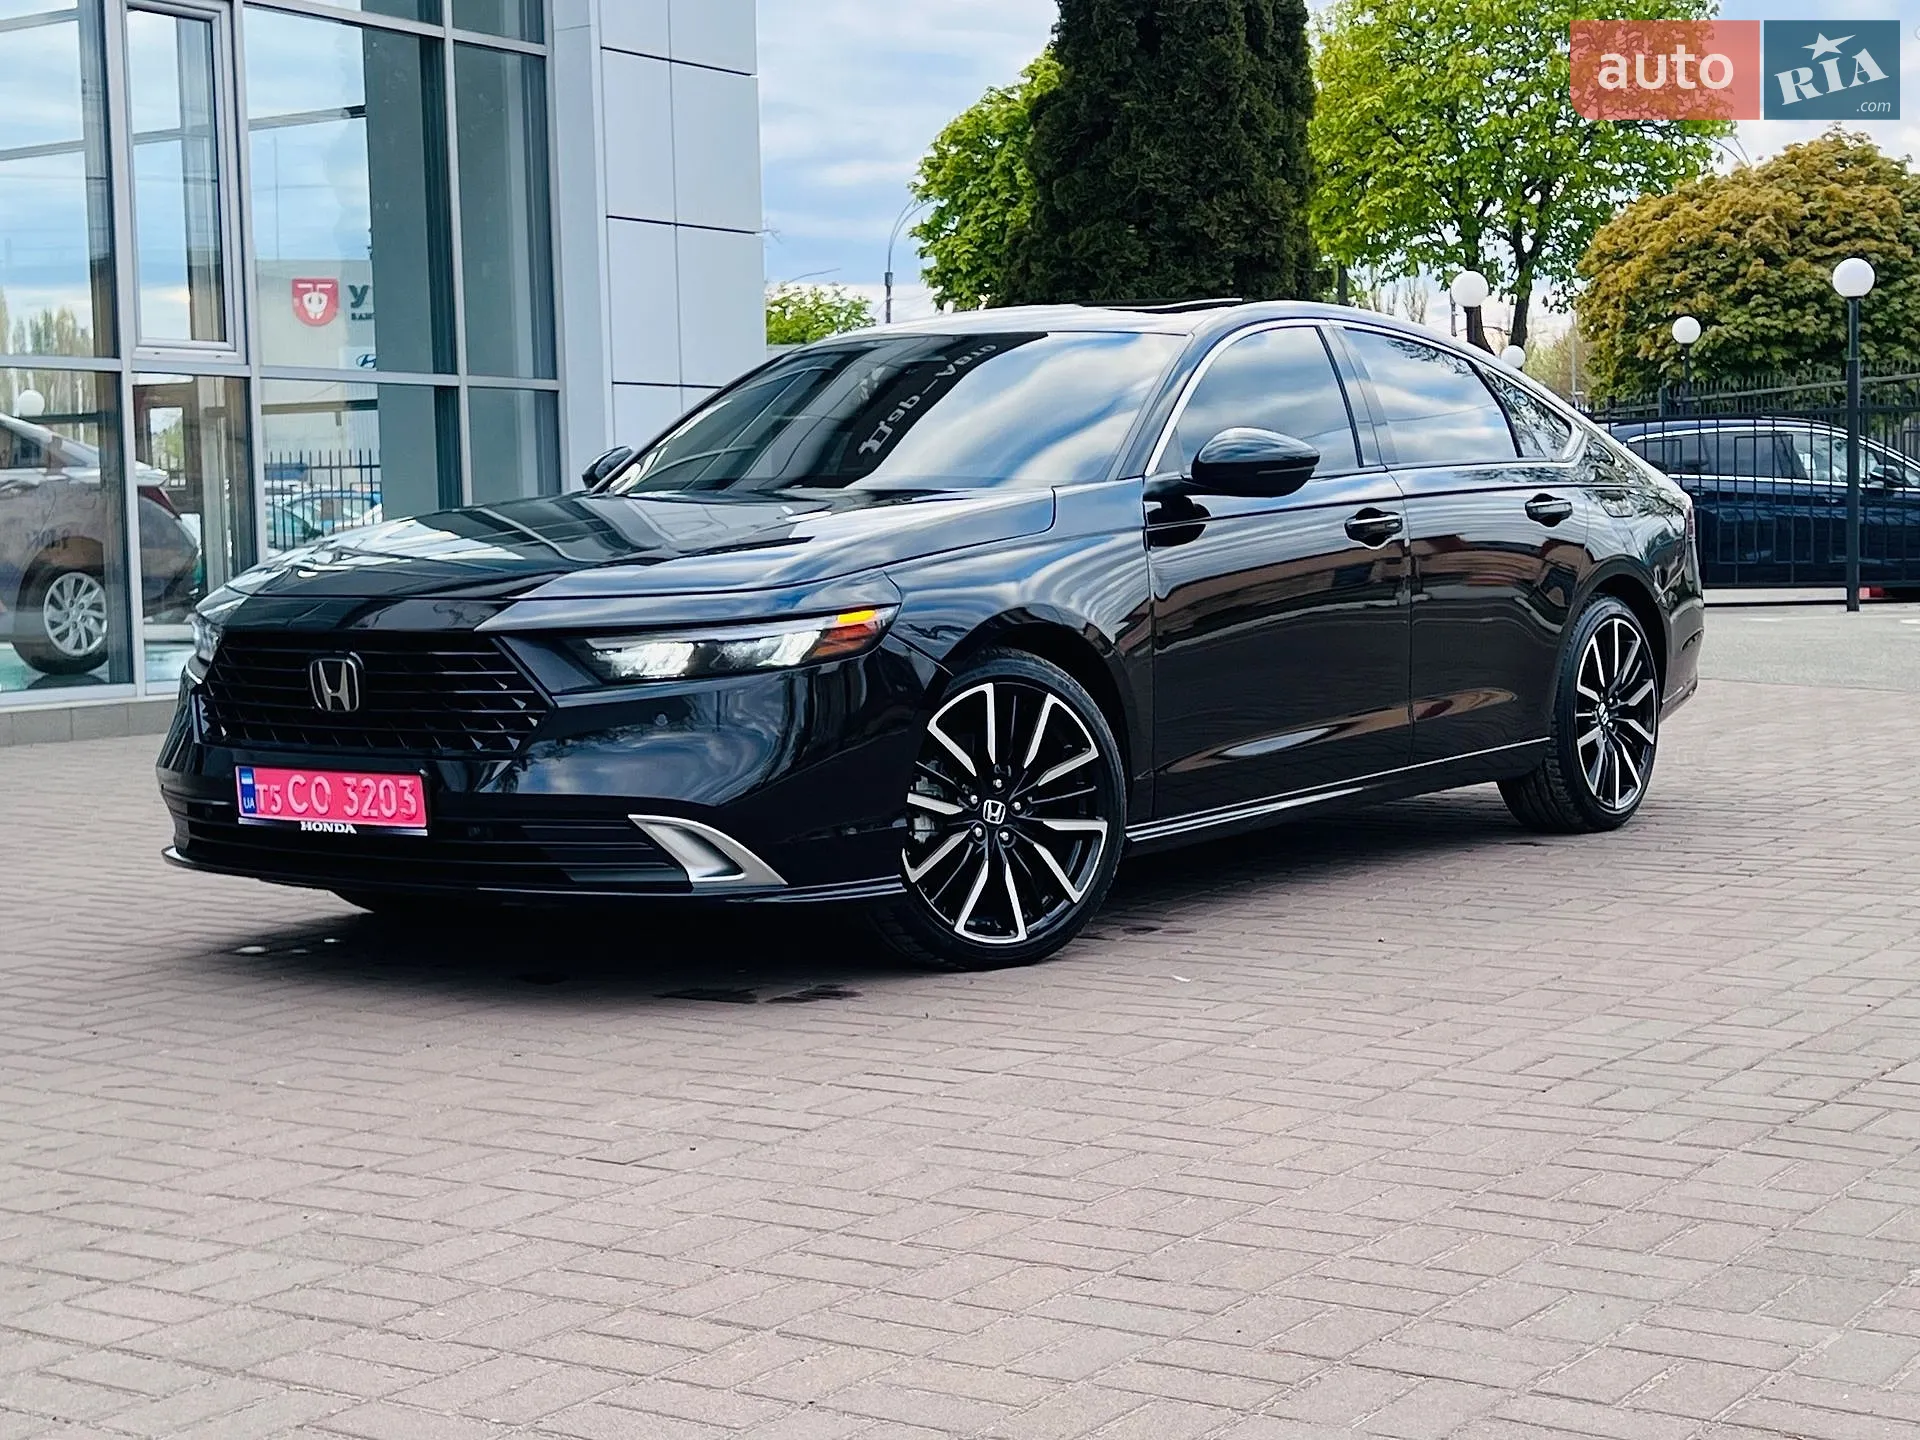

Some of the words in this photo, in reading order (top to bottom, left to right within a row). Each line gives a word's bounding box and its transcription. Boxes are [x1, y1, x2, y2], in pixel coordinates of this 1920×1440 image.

[243, 796, 256, 810] UA
[342, 776, 417, 819] 3203
[300, 821, 357, 834] HONDA
